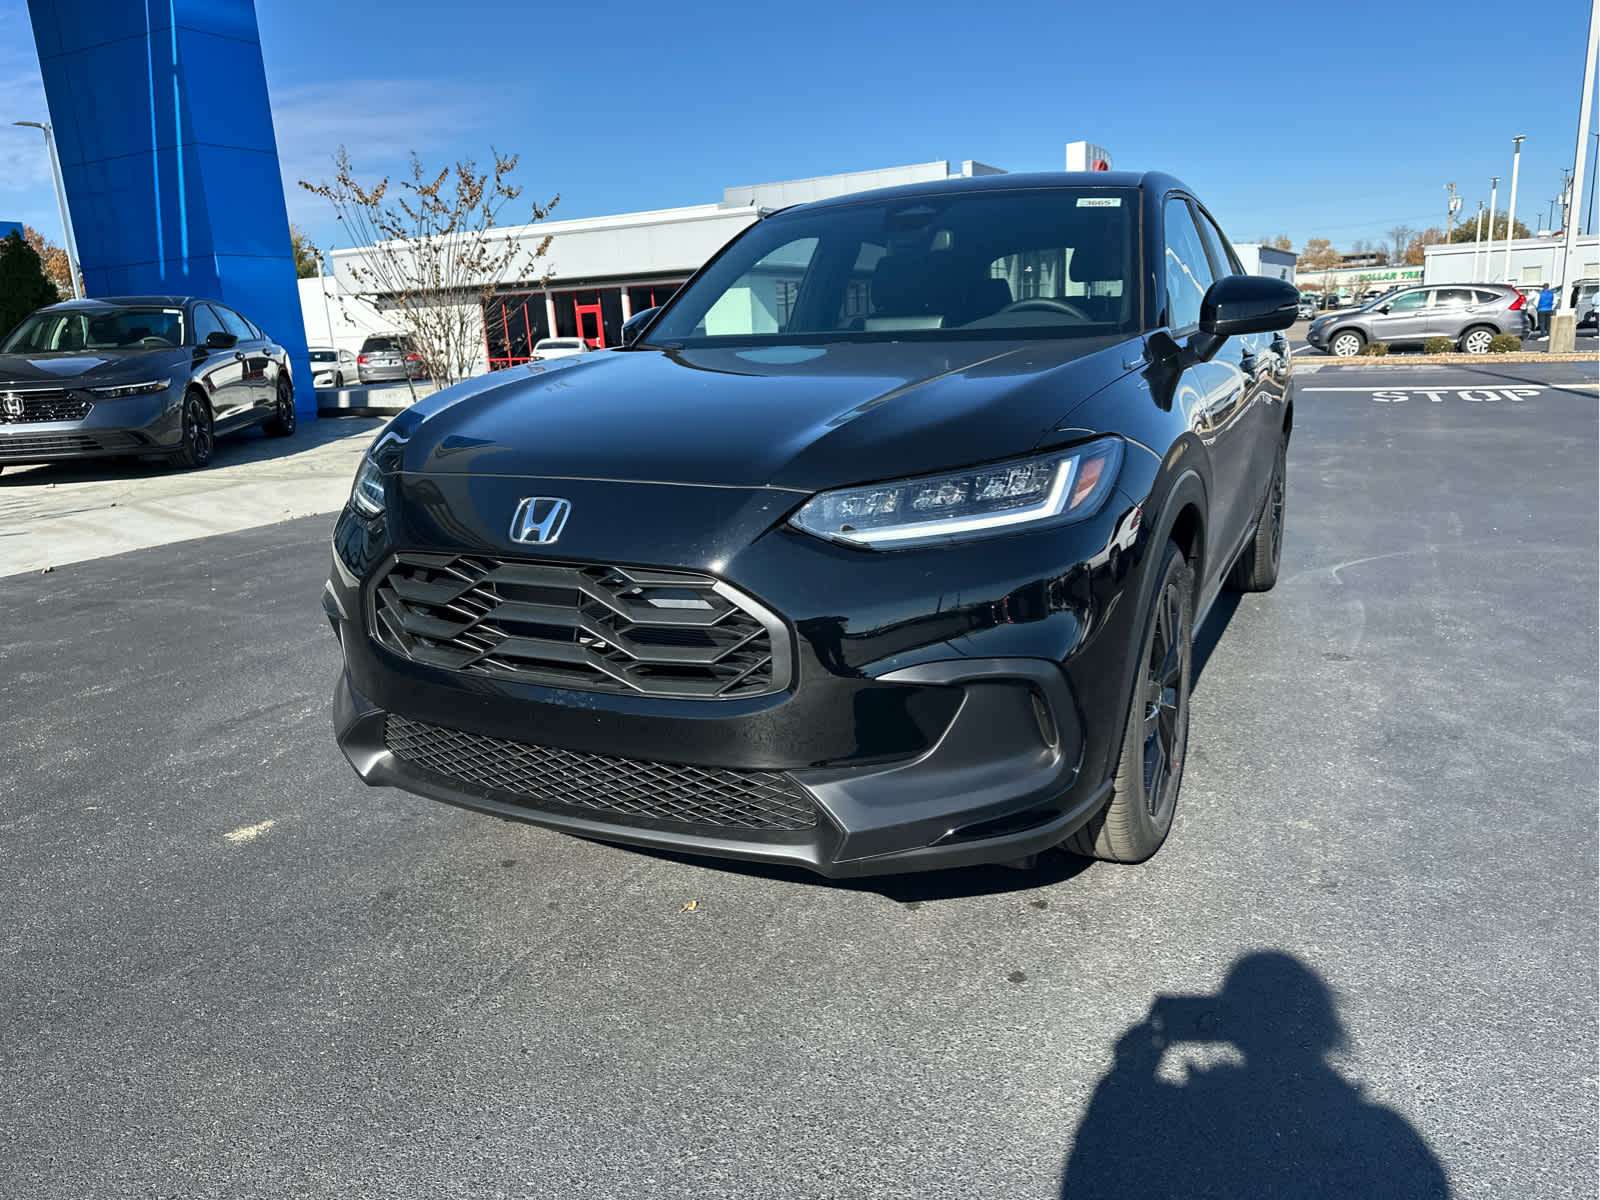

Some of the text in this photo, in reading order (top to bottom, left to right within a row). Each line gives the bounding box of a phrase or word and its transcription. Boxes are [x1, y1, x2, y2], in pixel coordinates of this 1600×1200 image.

[1359, 271, 1423, 281] DOLLAR TRE
[1372, 389, 1541, 402] STOP
